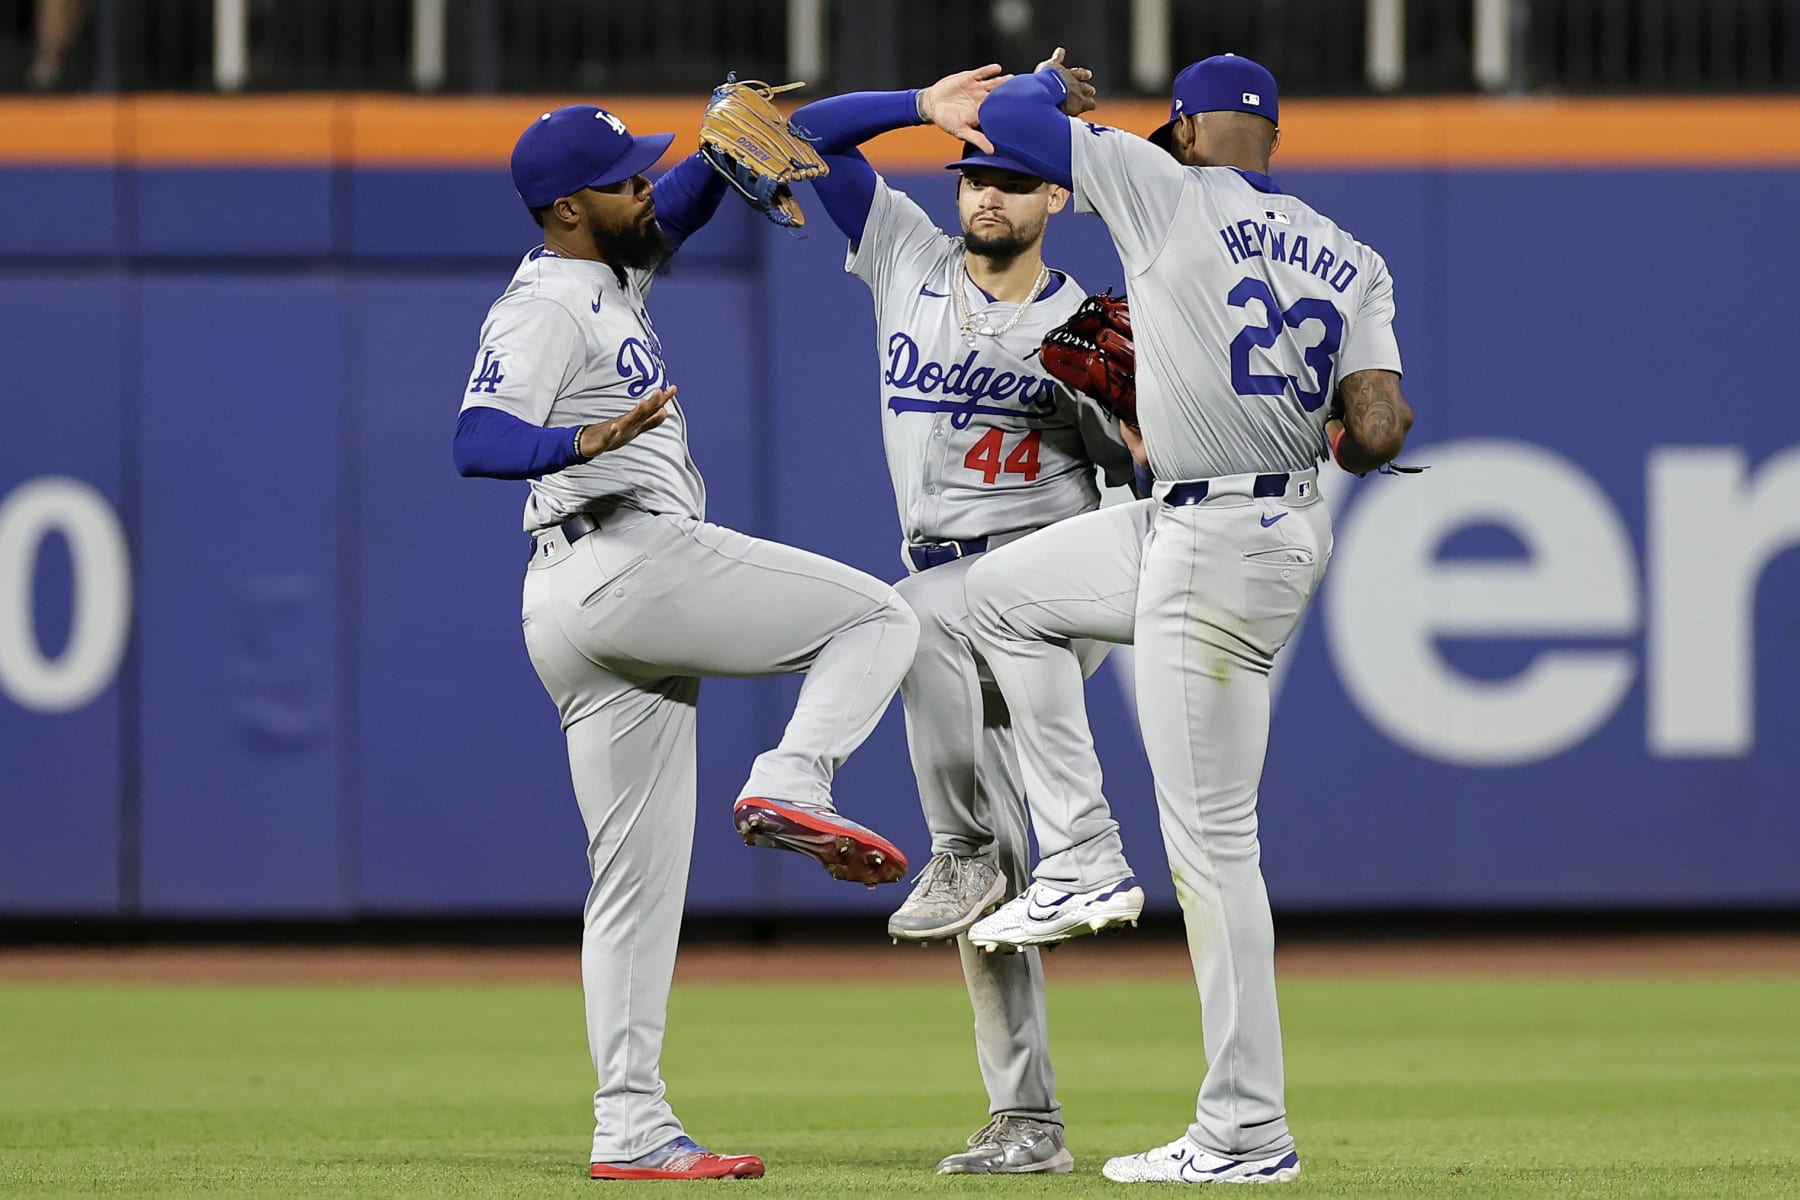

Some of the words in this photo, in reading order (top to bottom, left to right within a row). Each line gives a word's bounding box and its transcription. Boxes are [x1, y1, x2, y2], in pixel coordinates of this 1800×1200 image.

[595, 111, 626, 135] LA
[1220, 219, 1358, 293] HEYWARD
[470, 350, 504, 393] LA
[1227, 276, 1344, 412] 23
[884, 331, 1057, 430] Dodgers
[963, 427, 1042, 485] 44
